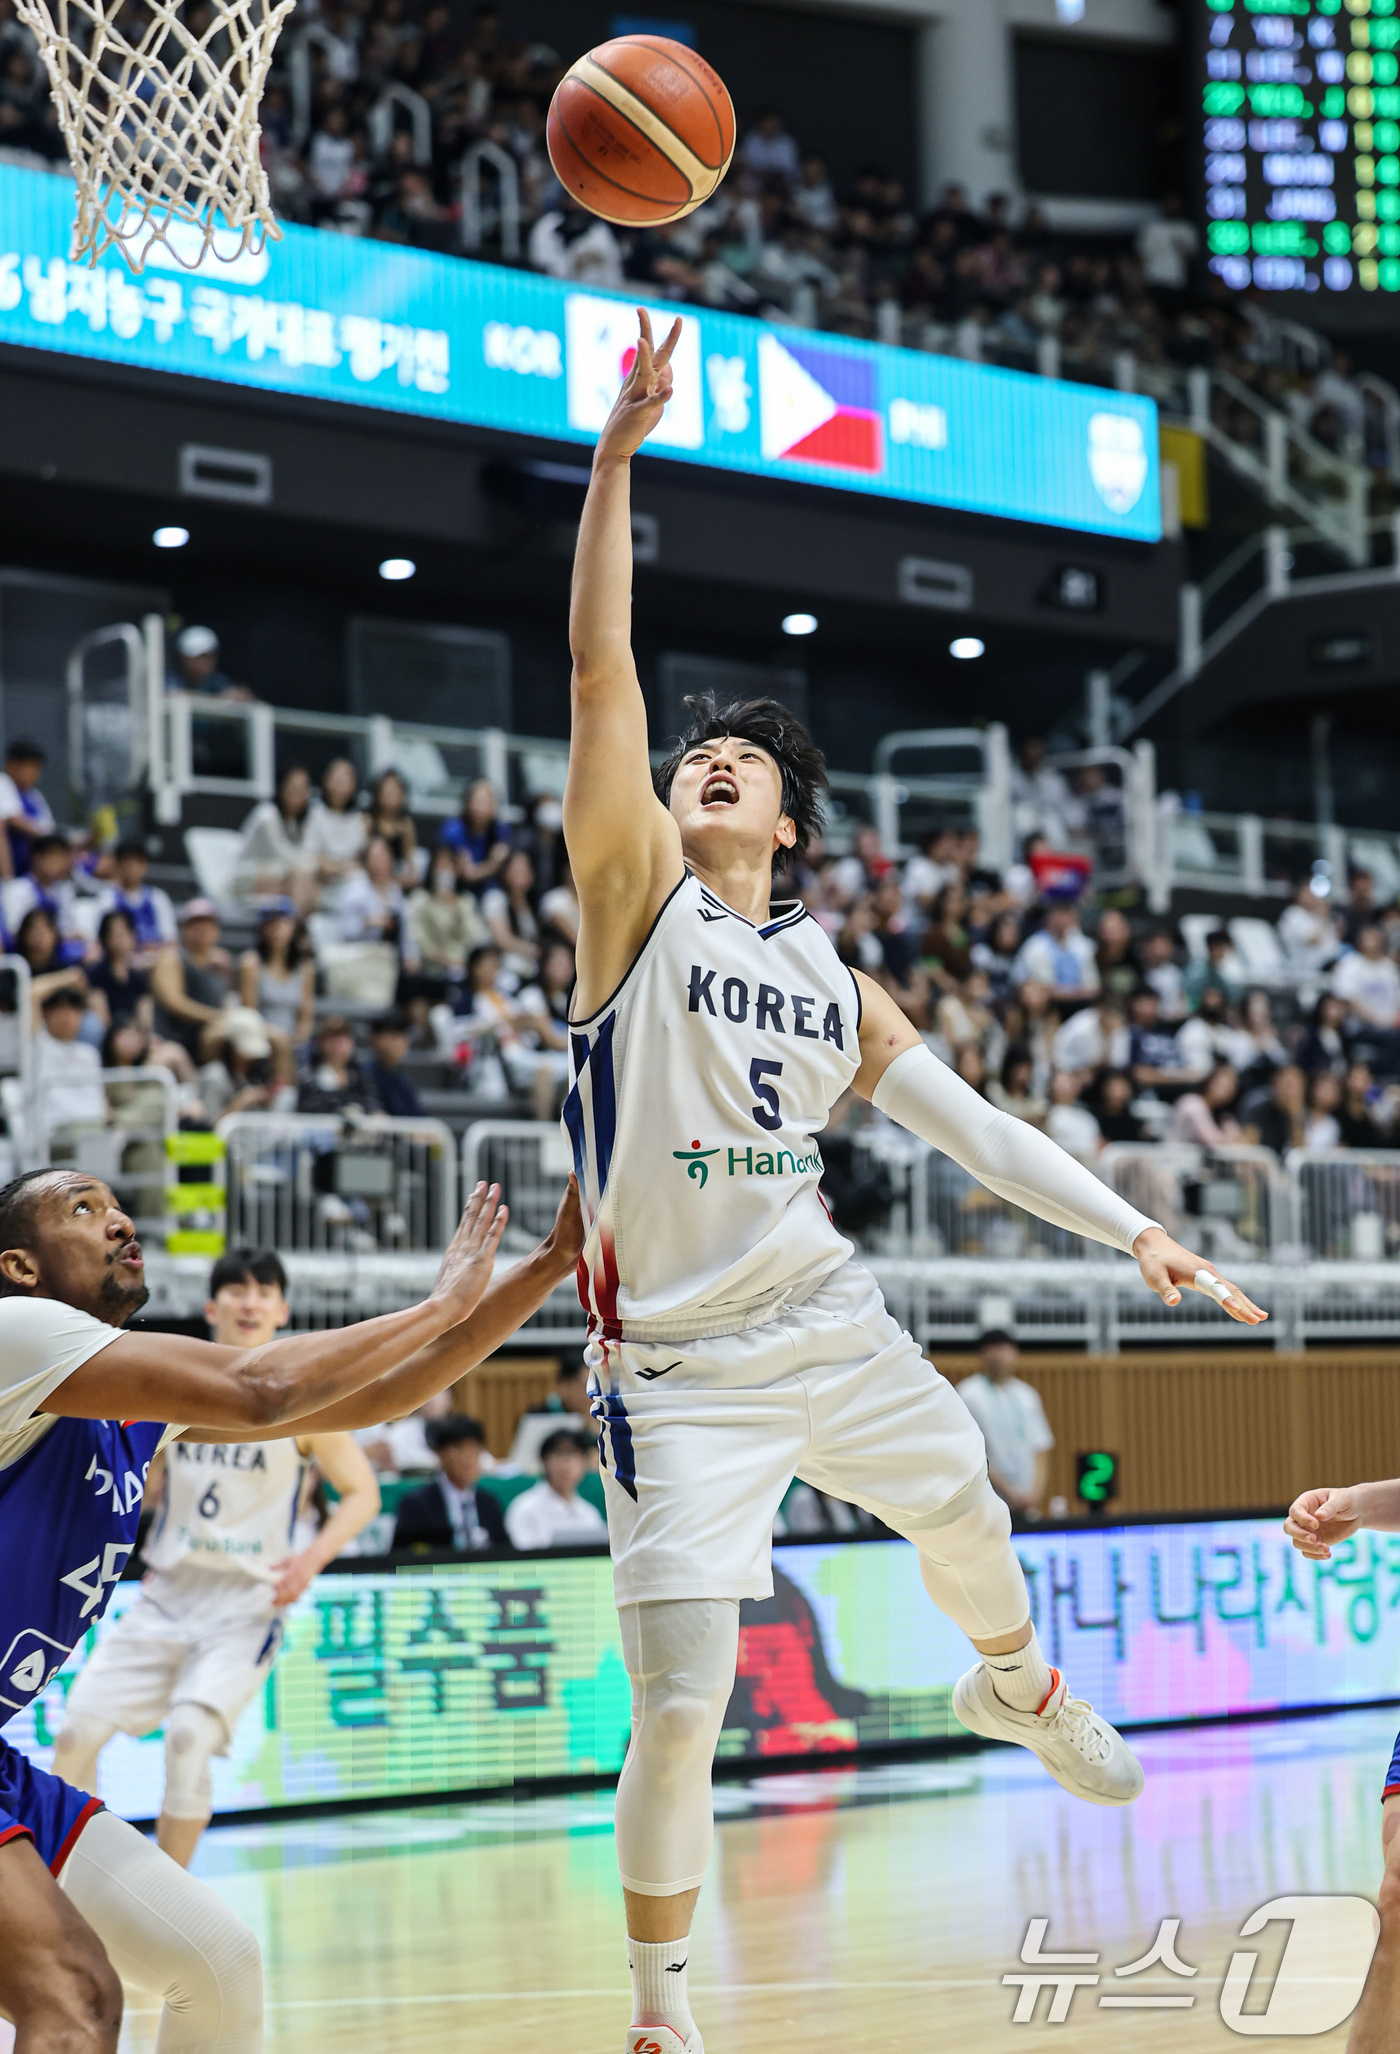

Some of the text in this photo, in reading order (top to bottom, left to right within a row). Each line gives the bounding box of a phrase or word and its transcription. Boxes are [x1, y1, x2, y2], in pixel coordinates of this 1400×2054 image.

[22, 253, 184, 342] 남자농구
[191, 287, 341, 370] 국가대표
[340, 314, 450, 395] 평가전
[483, 320, 562, 379] KOR
[687, 965, 844, 1051] KOREA
[749, 1057, 784, 1130] 5
[176, 1442, 267, 1473] KOREA
[1079, 1452, 1114, 1501] 2
[199, 1481, 220, 1519] 6
[314, 1587, 556, 1728] 필수품
